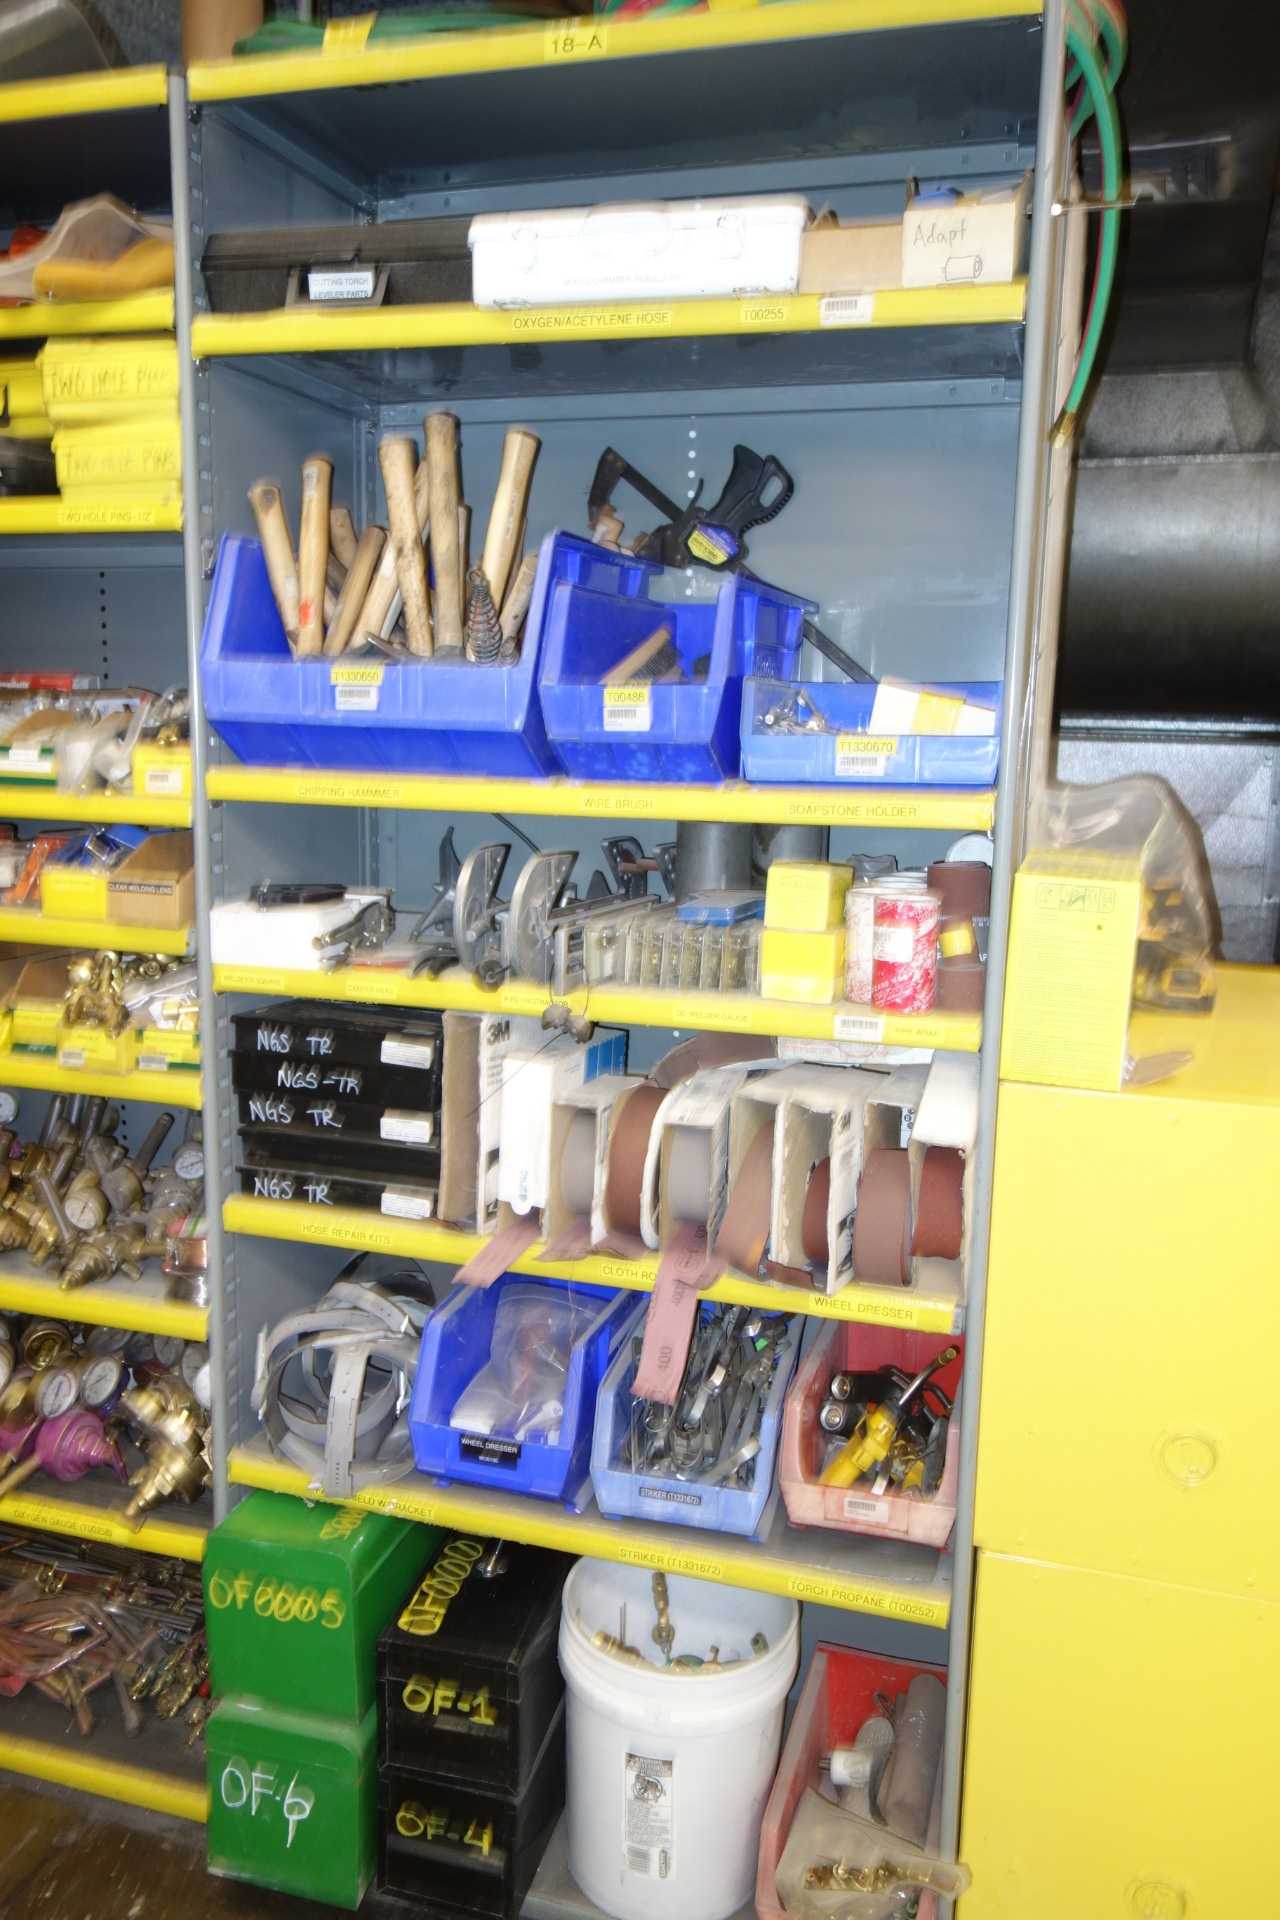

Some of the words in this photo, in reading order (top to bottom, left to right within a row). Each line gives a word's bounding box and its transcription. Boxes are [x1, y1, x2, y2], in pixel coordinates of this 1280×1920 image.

[552, 34, 602, 54] 18-A
[913, 218, 968, 248] Adapt
[513, 313, 632, 329] OXYGEN/ACETYLENE
[636, 311, 669, 323] HOSE
[743, 308, 785, 321] T00255
[788, 803, 862, 816] SOAPSTONE
[866, 806, 918, 818] HOLDER
[256, 1028, 291, 1053] NGS
[488, 1020, 511, 1044] 3M
[249, 1100, 292, 1124] NGS
[253, 1177, 293, 1200] NGS
[602, 1264, 638, 1279] CLOTH
[641, 1271, 657, 1282] RO
[814, 1296, 854, 1312] WHEEL
[857, 1303, 913, 1321] DRESSER
[619, 1548, 665, 1566] STRIKER
[791, 1581, 829, 1597] TORCH
[831, 1589, 887, 1608] PROPANE
